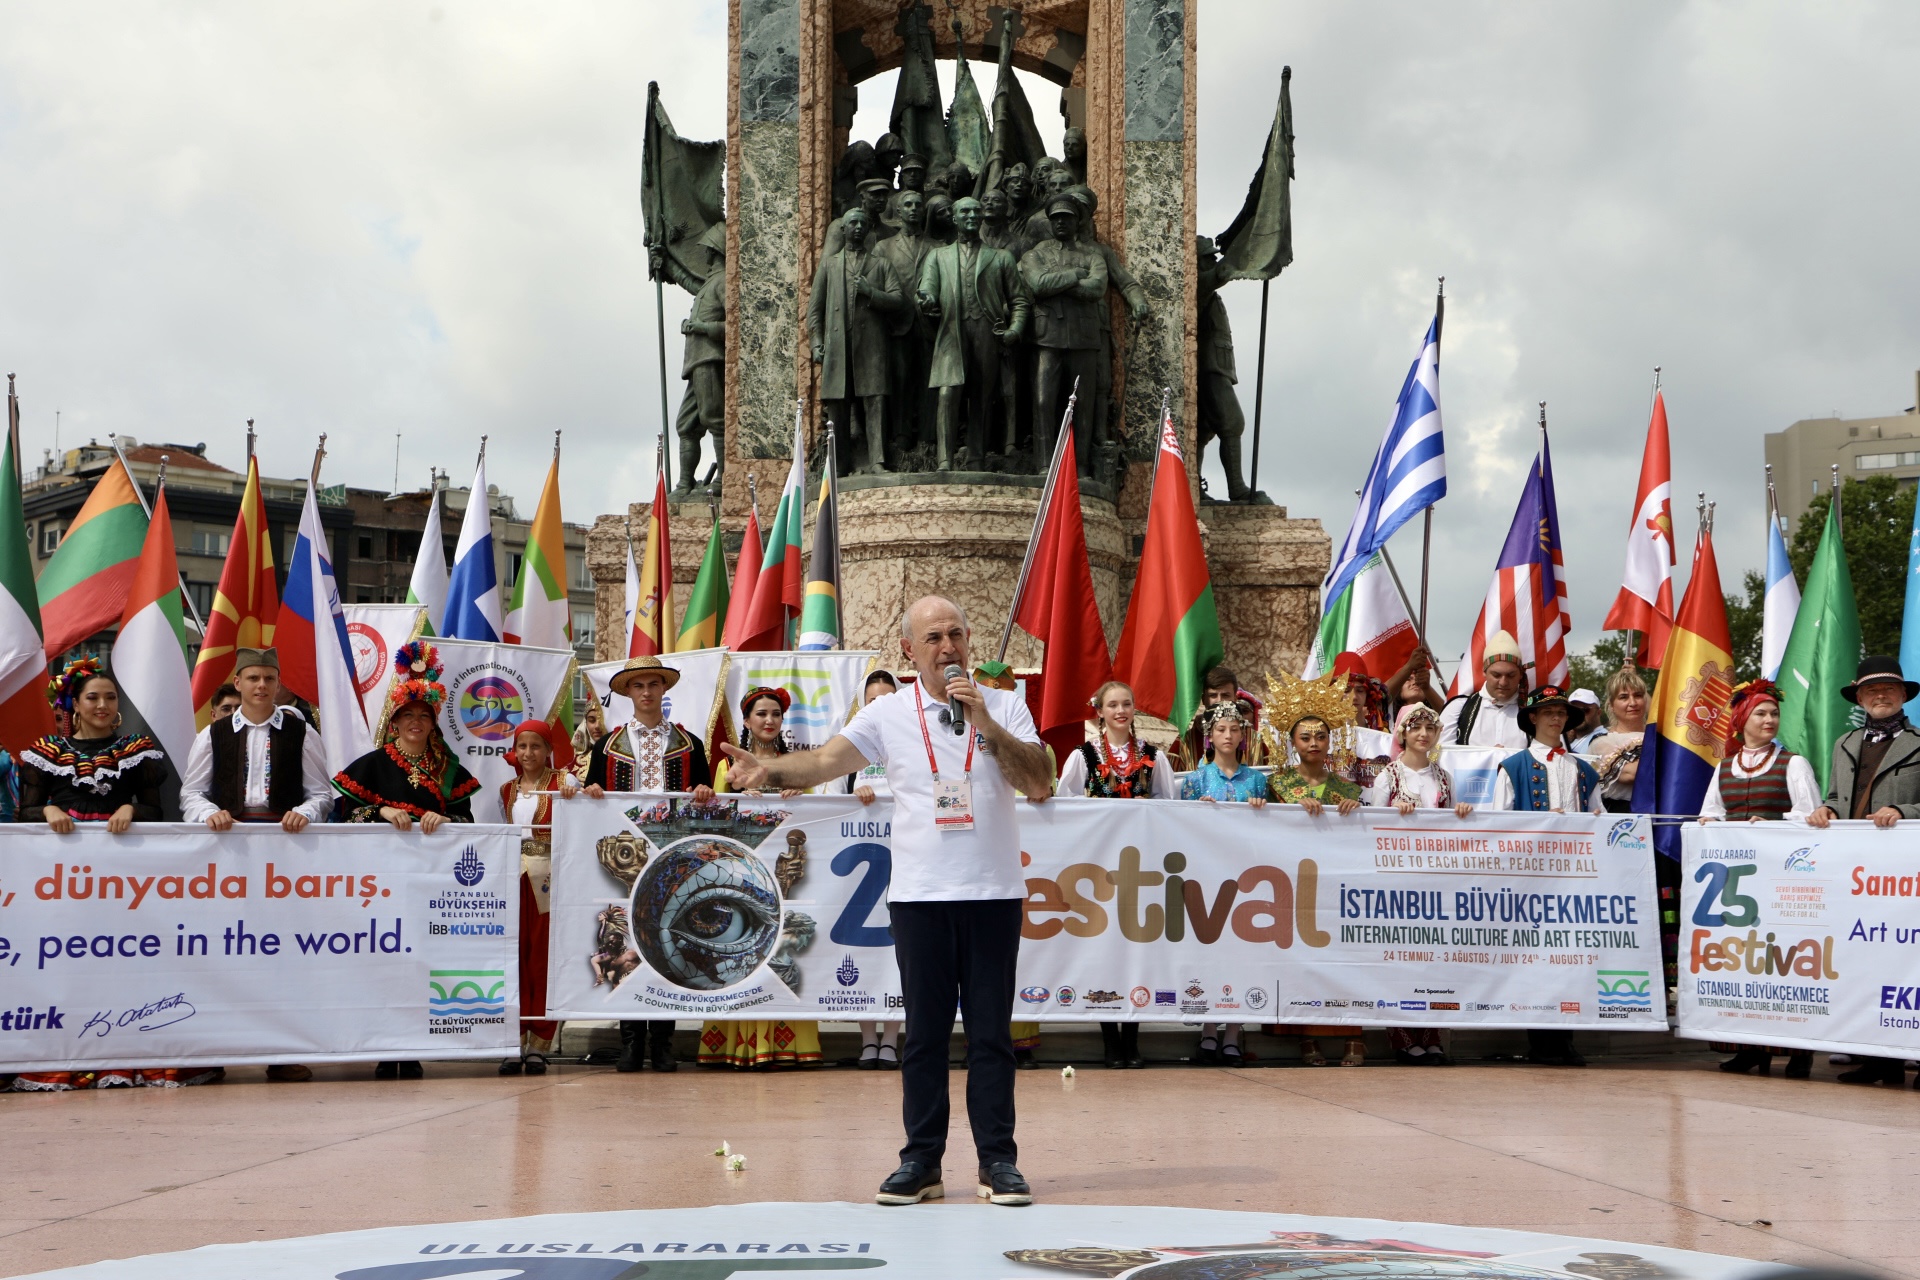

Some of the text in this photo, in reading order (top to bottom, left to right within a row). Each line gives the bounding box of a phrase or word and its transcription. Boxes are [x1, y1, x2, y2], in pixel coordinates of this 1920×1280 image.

[459, 661, 517, 680] International
[454, 678, 461, 689] of
[516, 674, 532, 703] Dance
[446, 691, 464, 742] Federation
[1376, 836, 1593, 856] SEVGİ BİRBİRİMİZE, BARIŞ HEPİMİZE
[1620, 841, 1647, 850] Türkiye
[1700, 849, 1756, 860] ULUSLARARASI
[1374, 854, 1598, 872] LOVE TO EACH OTHER, PEACE FOR ALL
[34, 863, 247, 910] dünyada
[265, 863, 391, 908] barış.
[441, 890, 495, 898] İSTANBUL
[429, 898, 507, 910] BÜYÜKŞEHİR
[1020, 845, 1332, 950] estival
[1340, 883, 1638, 929] İSTANBUL BÜYÜKÇEKMECE
[1341, 925, 1640, 949] INTERNATIONAL CULTURE AND ART FESTIVAL
[1848, 917, 1888, 942] Art
[38, 934, 161, 970] peace
[176, 923, 208, 956] in
[223, 920, 281, 956] the
[294, 917, 412, 956] world.
[1383, 950, 1395, 961] 24
[1397, 951, 1435, 962] TEMMUZ
[1443, 952, 1449, 963] 3
[1452, 950, 1490, 964] AĞUSTOS
[1500, 953, 1519, 964] JULY
[1549, 954, 1585, 965] AUGUST
[1690, 929, 1839, 980] Festival
[645, 986, 656, 994] 75
[656, 988, 679, 1001] ÜLKE
[818, 996, 876, 1005] BÜYÜKŞEHİR
[1697, 978, 1830, 1004] İSTANBUL BÜYÜKÇEKMECE
[633, 993, 643, 1002] 75
[644, 998, 693, 1013] COUNTRIES
[706, 993, 775, 1013] BÜYÜKÇEKMECE
[1698, 997, 1830, 1016] INTERNATIONAL CULTURE AND ART FESTIVAL
[0, 1006, 66, 1031] türk
[429, 1016, 505, 1026] T.C. BÜYÜKÇEKMECE
[1880, 1012, 1920, 1029] İstanb
[429, 1025, 472, 1034] BELEDİYESİ
[417, 1242, 872, 1255] ULUSLARARASI
